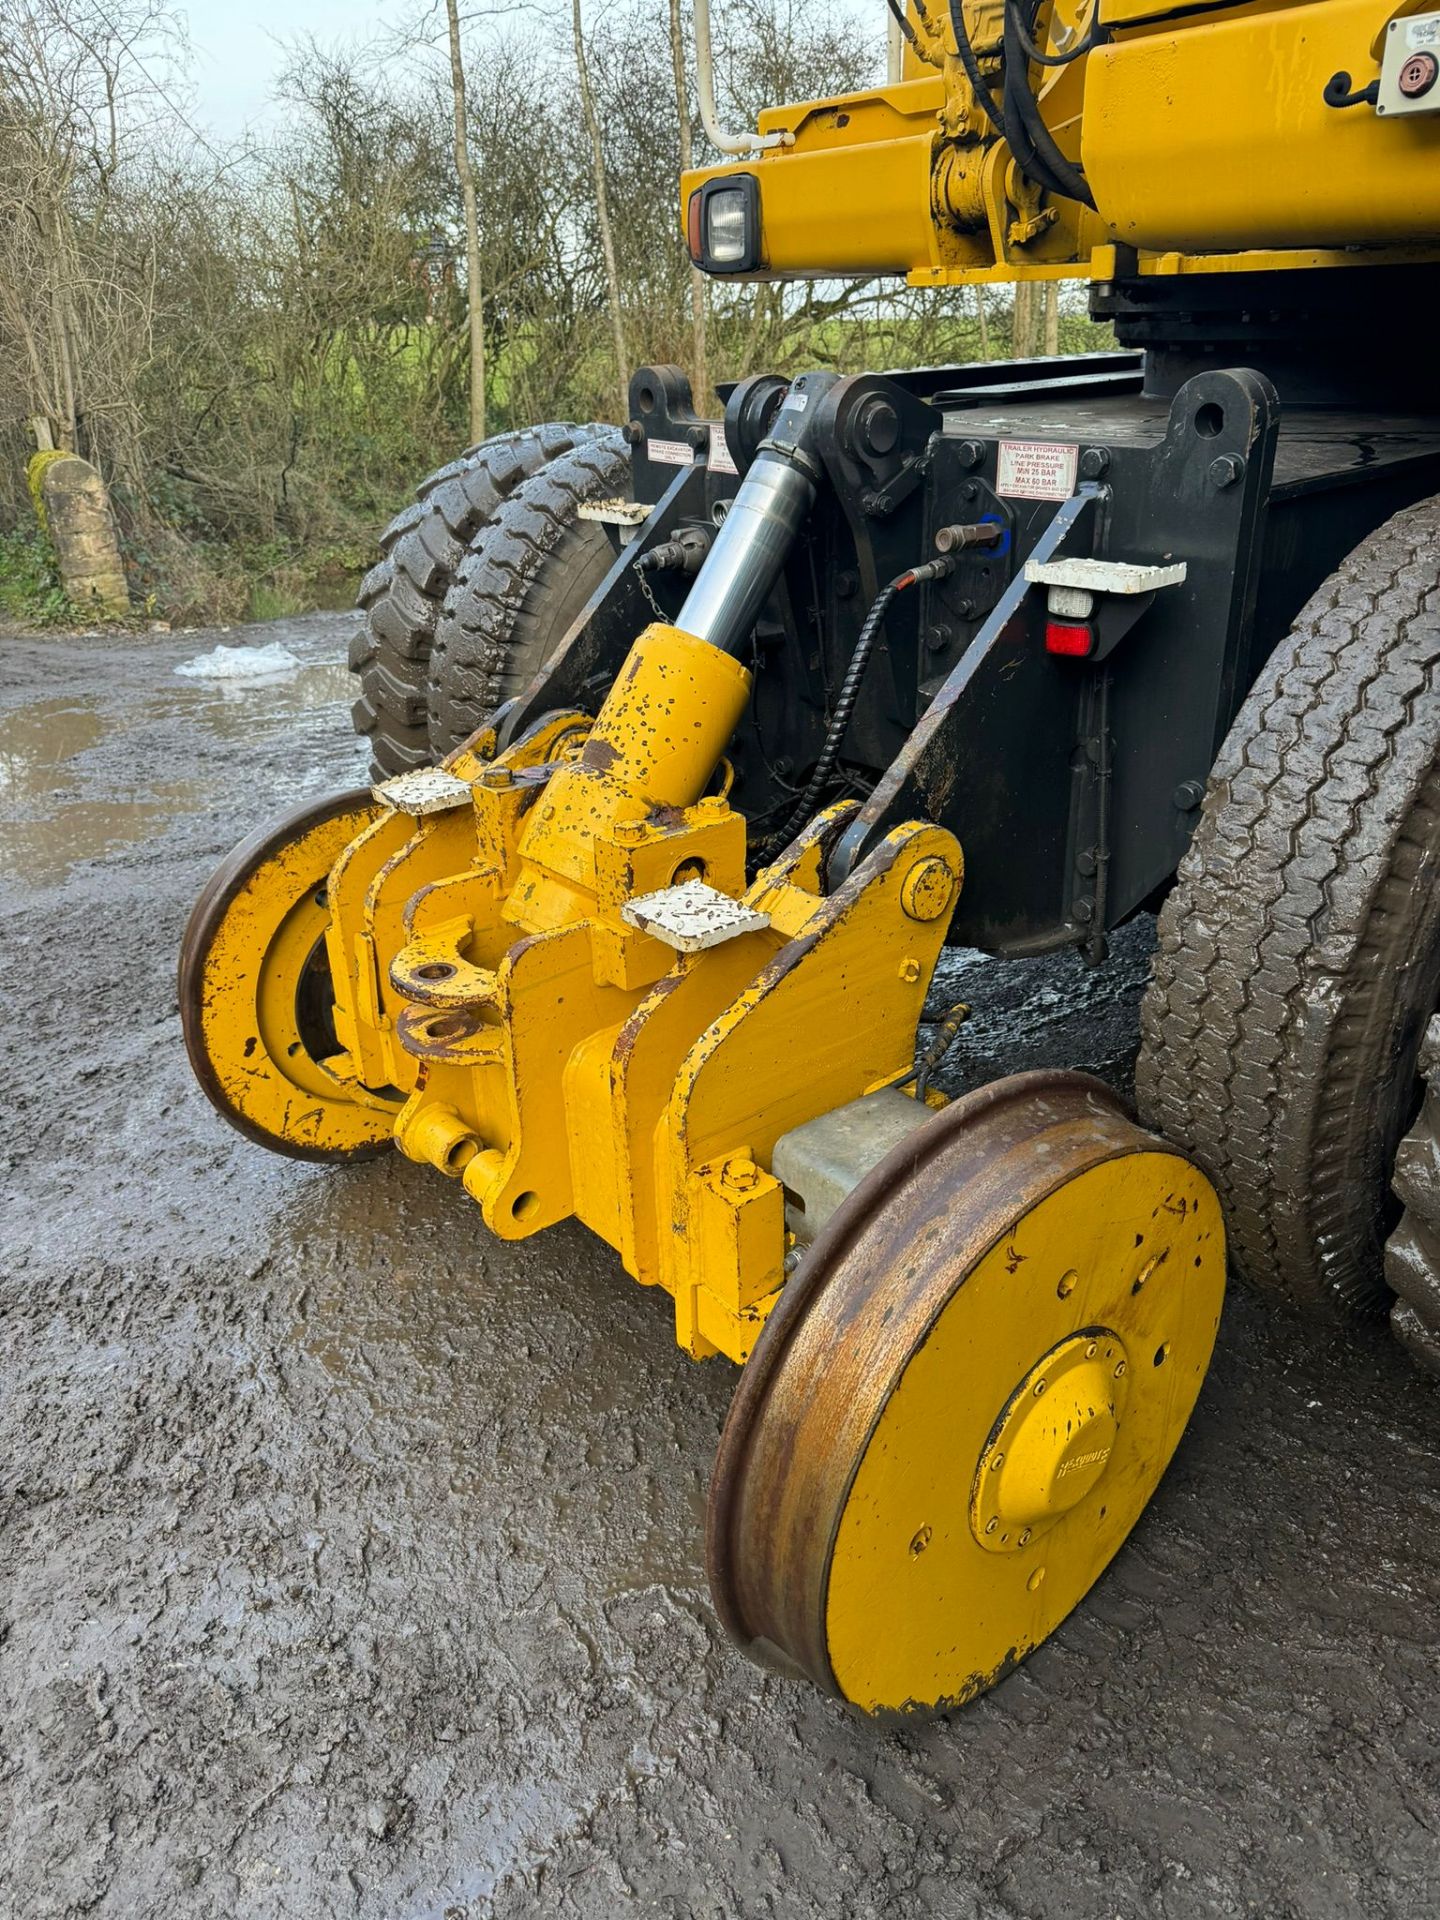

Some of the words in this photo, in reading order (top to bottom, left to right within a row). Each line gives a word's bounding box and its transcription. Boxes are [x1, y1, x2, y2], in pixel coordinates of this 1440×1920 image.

[1033, 447, 1074, 455] HYDRAULIC
[1026, 461, 1064, 469] PRESSURE
[1016, 467, 1030, 475] MIN
[1031, 468, 1040, 476] 25
[1041, 469, 1057, 477] BAR
[1015, 476, 1031, 484] MAX
[1041, 478, 1057, 486] BAR
